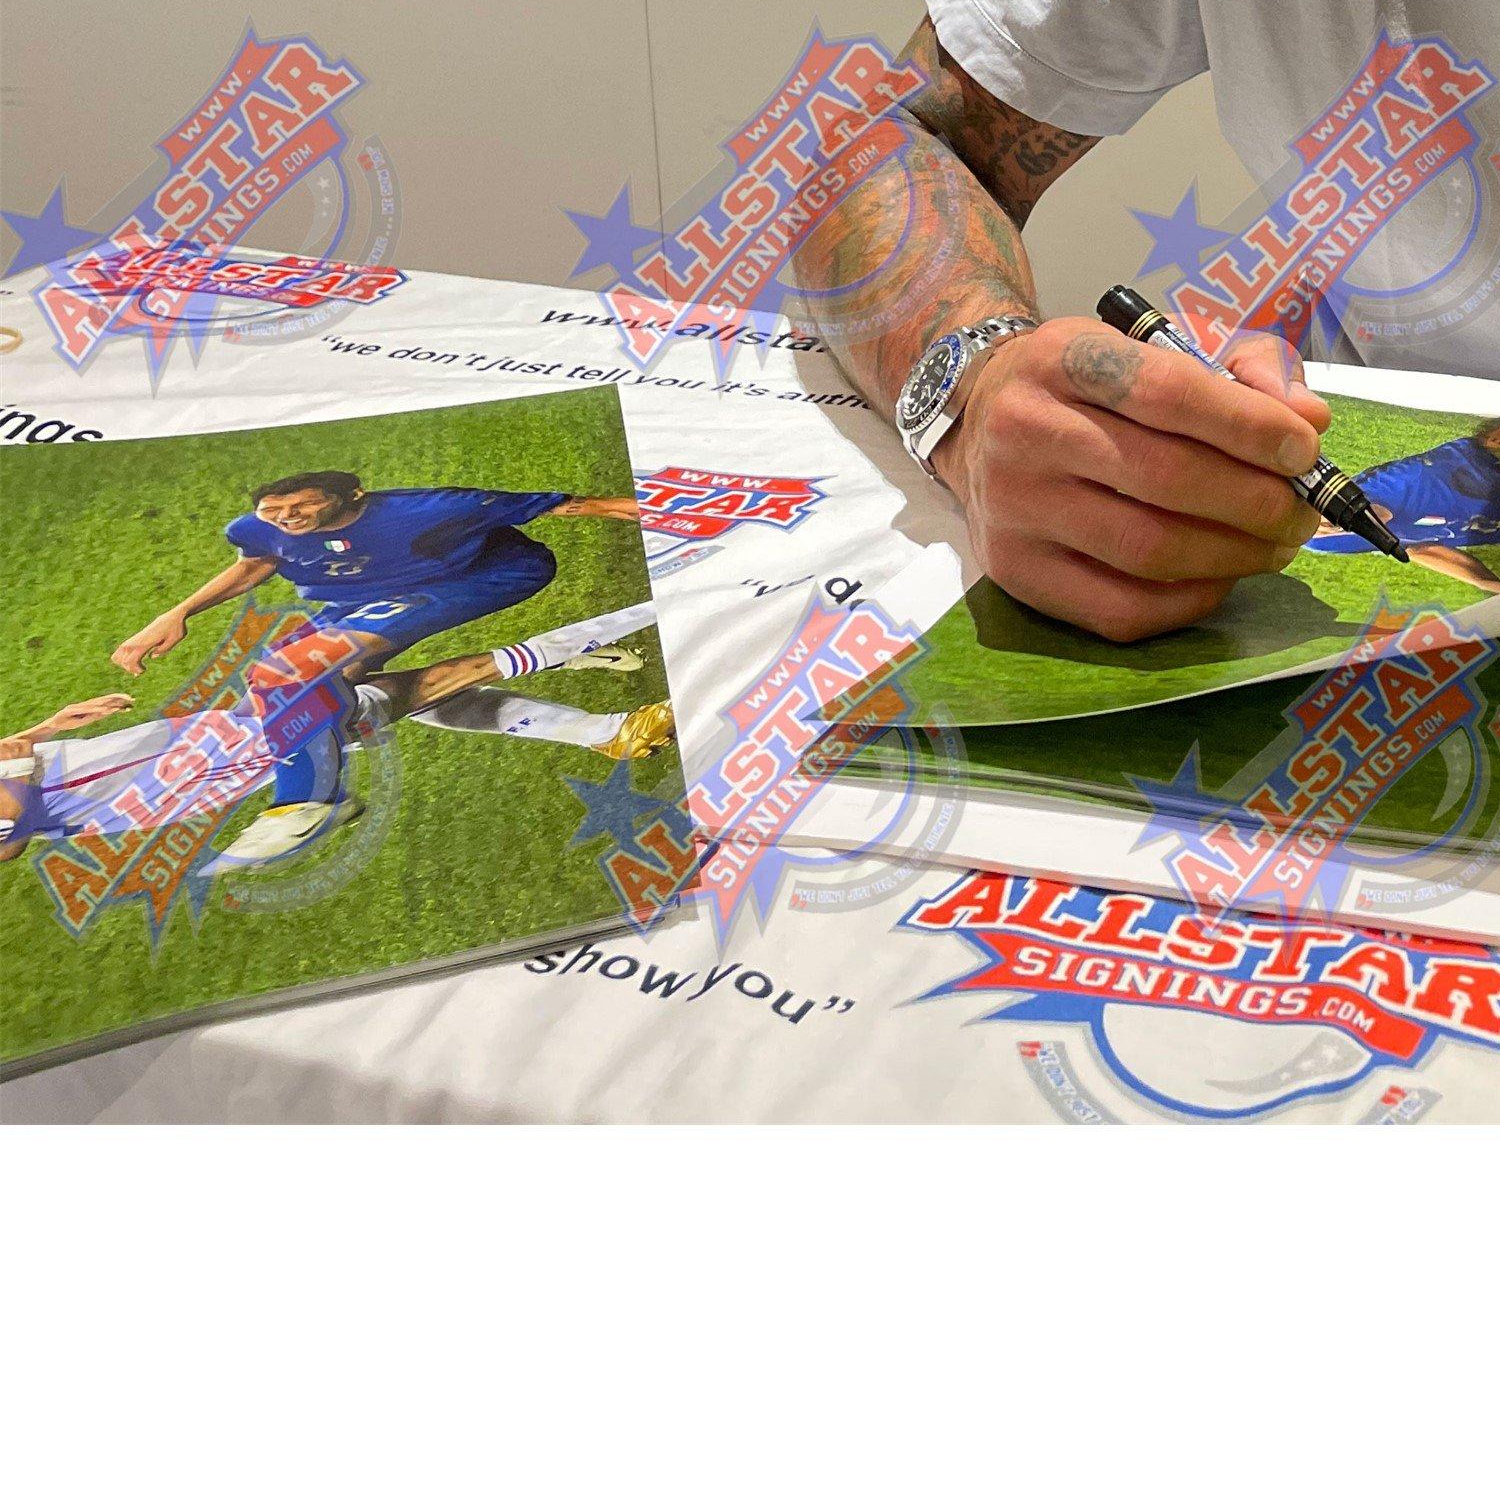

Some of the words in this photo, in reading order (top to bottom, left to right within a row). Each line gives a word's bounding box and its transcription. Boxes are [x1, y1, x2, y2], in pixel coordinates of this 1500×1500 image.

[540, 310, 829, 353] www.allsta
[476, 356, 564, 372] just
[567, 362, 632, 384] tell
[623, 372, 703, 390] you
[710, 379, 770, 397] it's
[523, 943, 689, 999] show
[1011, 945, 1309, 1017] SIGNINGS
